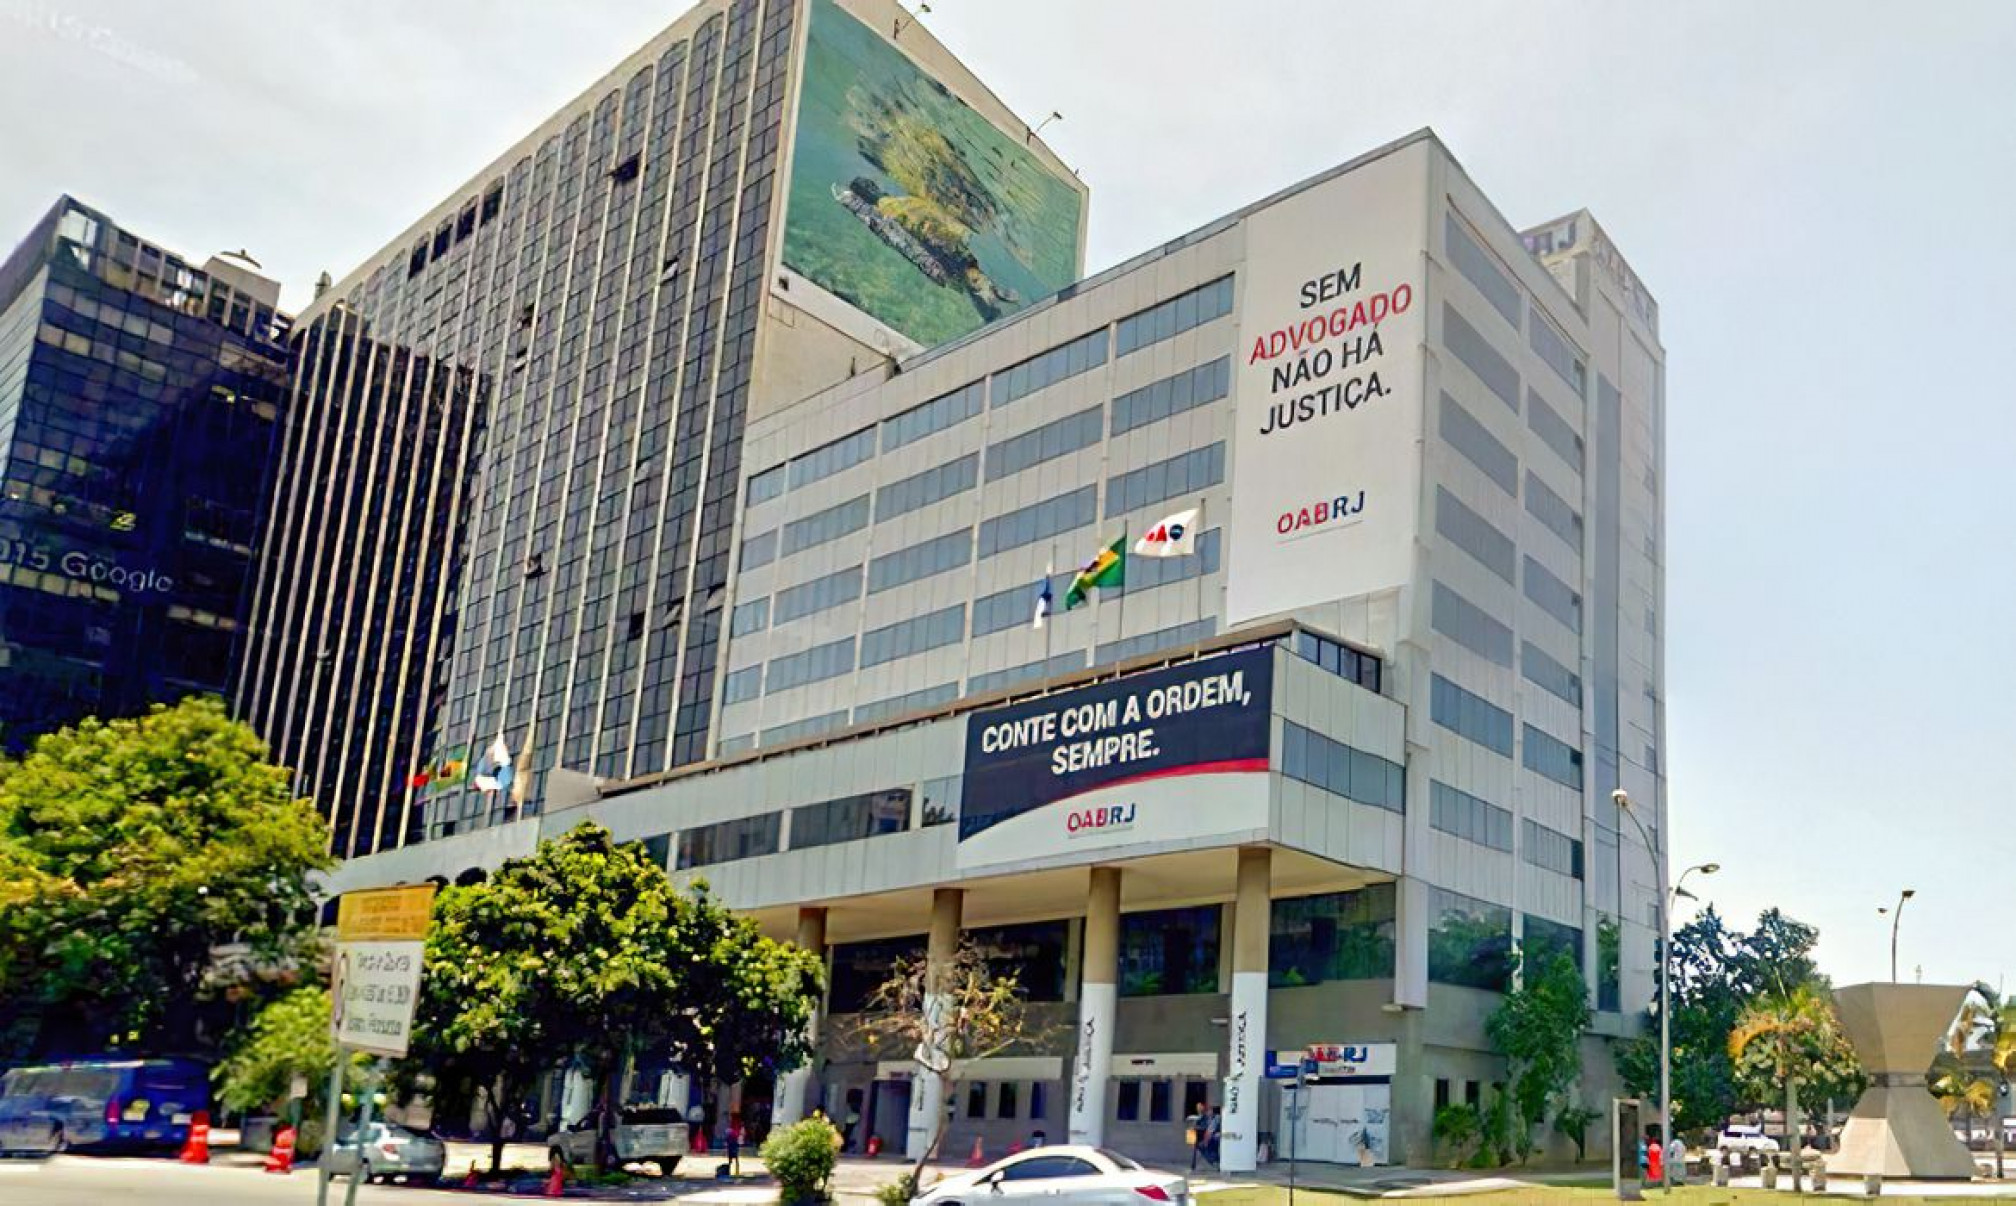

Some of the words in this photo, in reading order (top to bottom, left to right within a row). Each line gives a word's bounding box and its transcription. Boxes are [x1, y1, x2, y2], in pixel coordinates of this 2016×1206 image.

[1300, 261, 1362, 309] SEM
[1249, 283, 1413, 366] ADVOGADO
[1271, 349, 1333, 394] NÃO
[1341, 323, 1383, 369] HÁ
[1259, 371, 1392, 435] JUSTIÇA.
[1277, 490, 1365, 534] OABRJ
[981, 712, 1057, 754] CONTE
[1060, 699, 1118, 737] COM
[1122, 694, 1142, 726] A
[1146, 670, 1251, 720] ORDEM,
[1051, 728, 1161, 775] SEMPRE.
[1066, 802, 1136, 833] OABRJ
